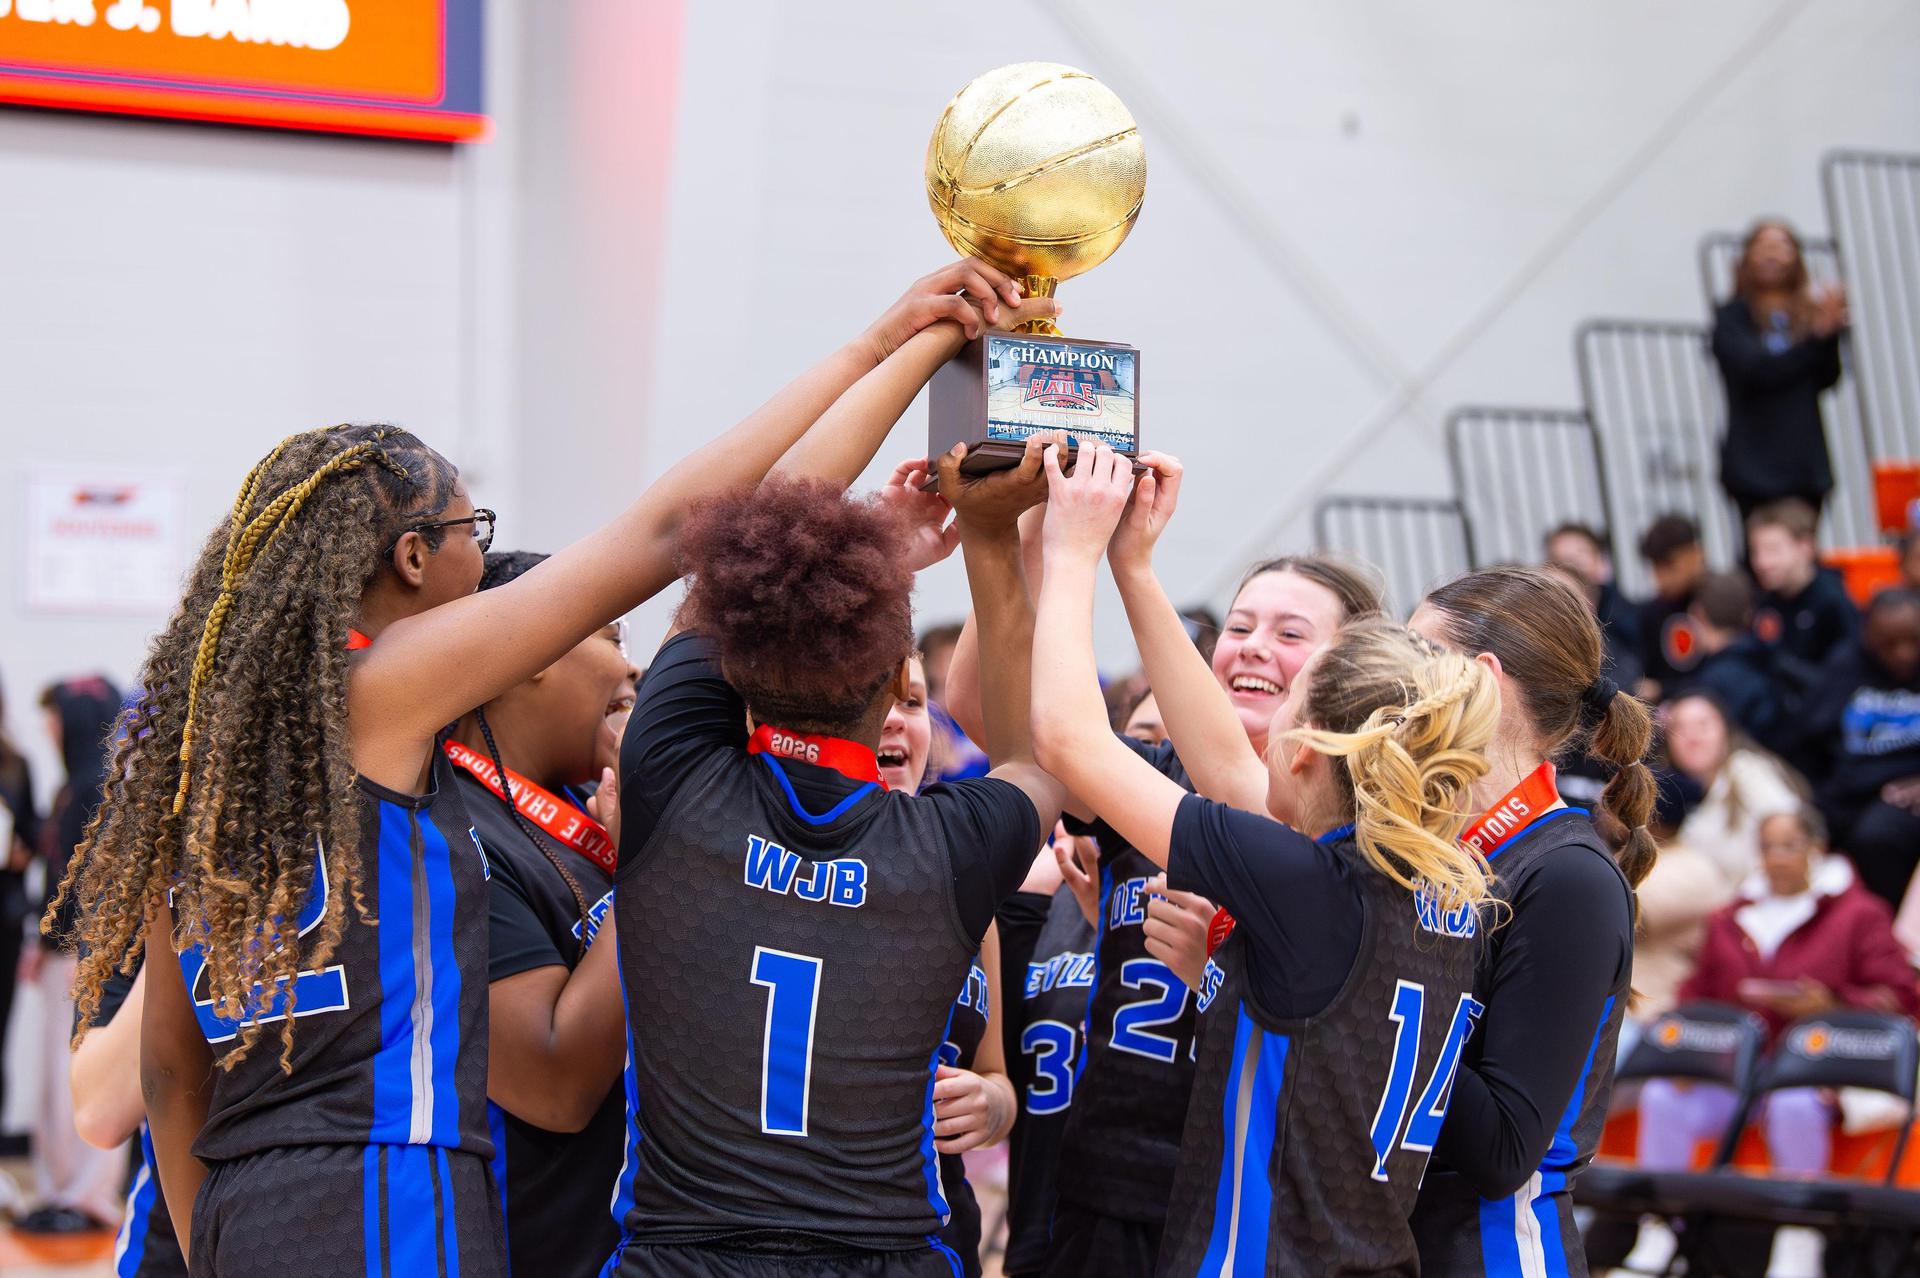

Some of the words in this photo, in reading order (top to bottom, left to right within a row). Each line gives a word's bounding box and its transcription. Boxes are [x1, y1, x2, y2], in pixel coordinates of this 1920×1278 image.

[1010, 346, 1114, 369] CHAMPION
[1028, 378, 1096, 404] HAILE
[1071, 430, 1100, 442] GIRLS
[1103, 432, 1130, 444] 2026
[770, 733, 819, 763] 2026
[447, 745, 559, 825] CHAMPIONS
[560, 817, 616, 866] STATE
[1464, 796, 1530, 859] PIONS
[744, 833, 868, 909] WJB
[750, 945, 823, 1137] 1
[1021, 1019, 1076, 1115] 3
[1370, 978, 1473, 1190] 14
